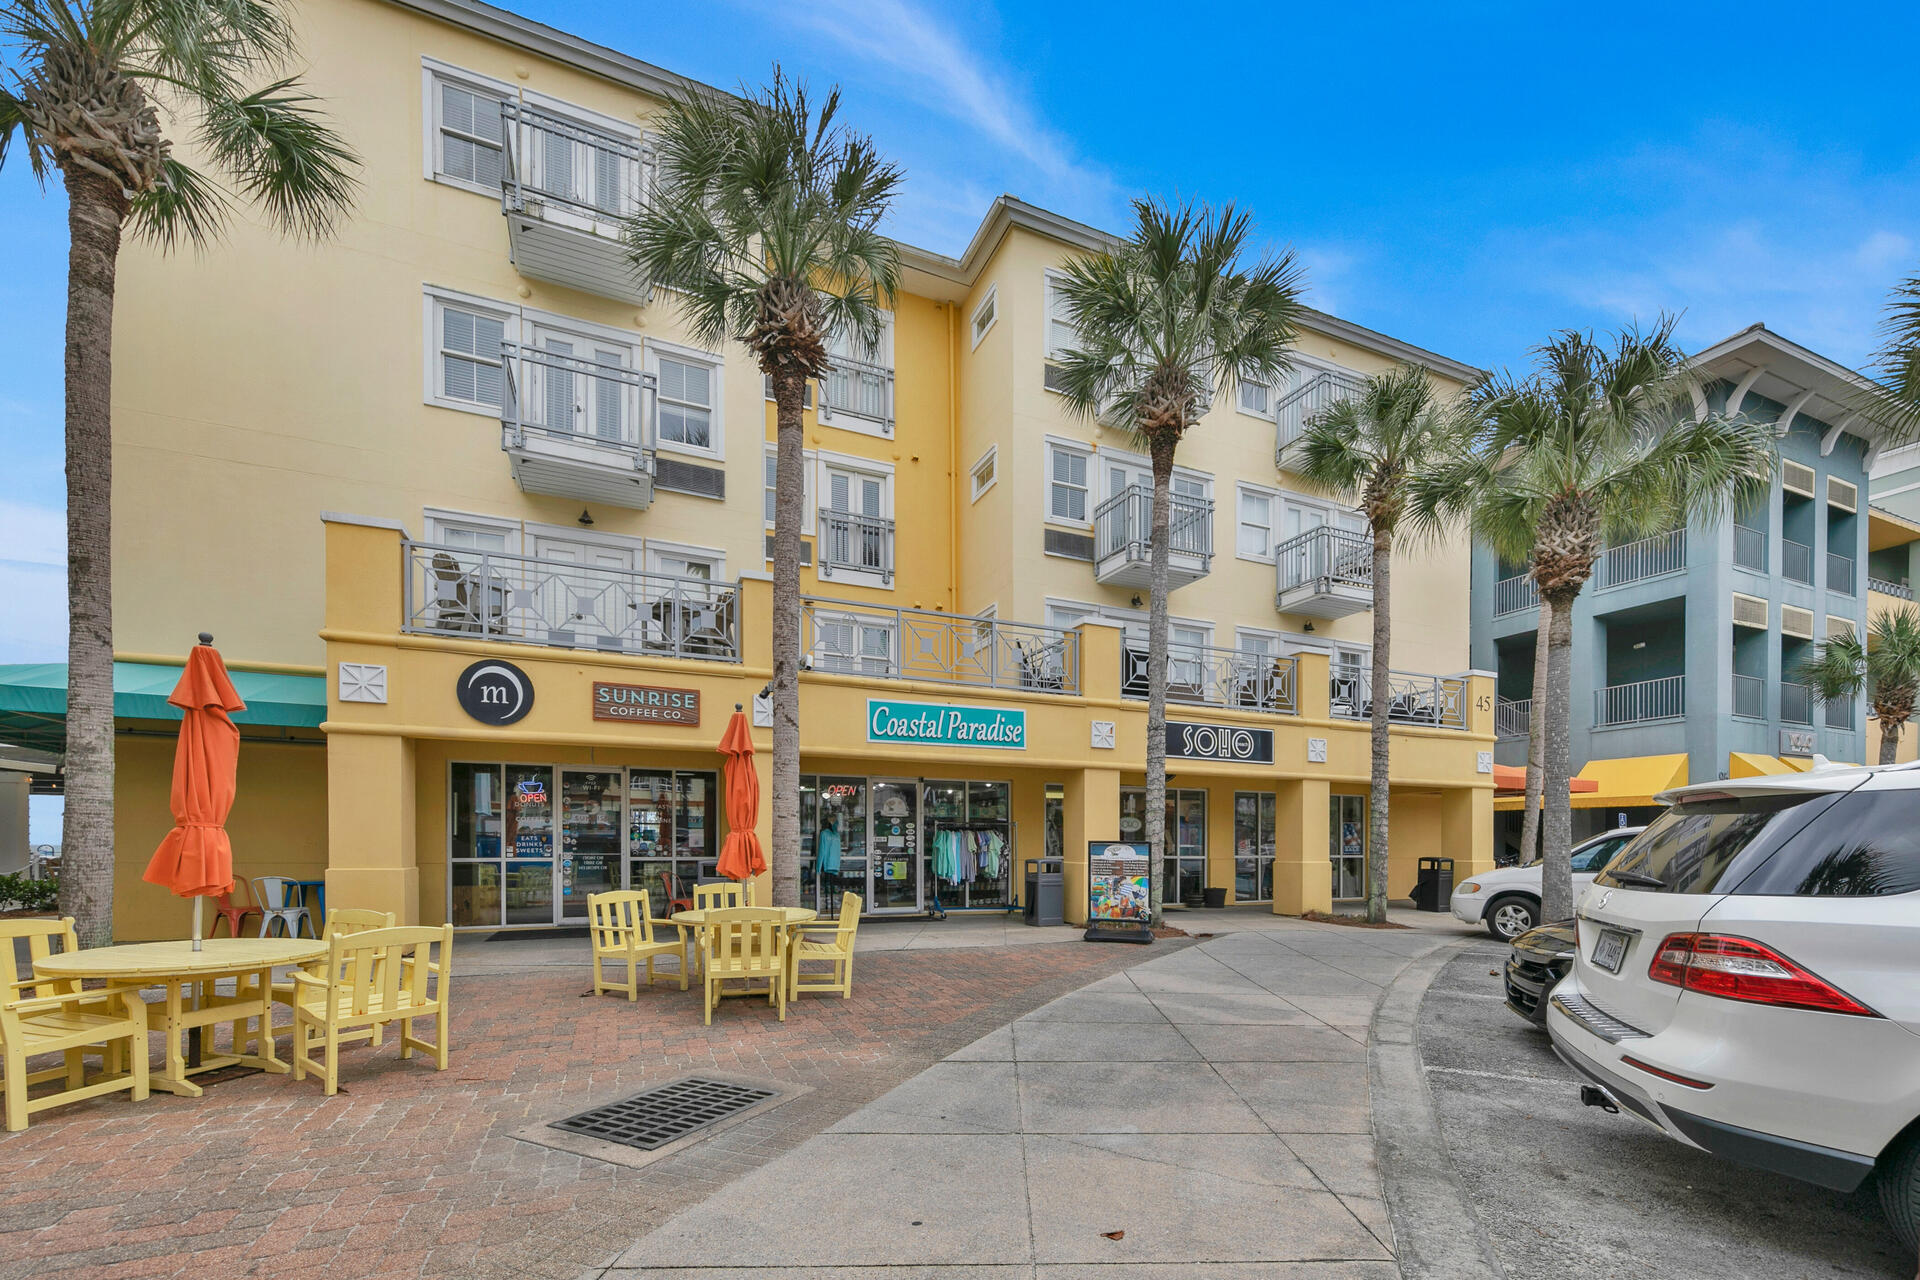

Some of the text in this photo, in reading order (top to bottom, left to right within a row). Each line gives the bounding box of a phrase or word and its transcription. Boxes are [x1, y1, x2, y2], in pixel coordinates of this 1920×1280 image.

[480, 685, 510, 704] m
[599, 687, 696, 709] SUNRISE
[1476, 695, 1491, 712] 45
[609, 706, 685, 720] COFFEE CO.
[872, 706, 1023, 743] Coastal Paradise
[1182, 725, 1255, 758] SOHO
[520, 793, 547, 803] OPEN
[828, 784, 857, 797] OPEN
